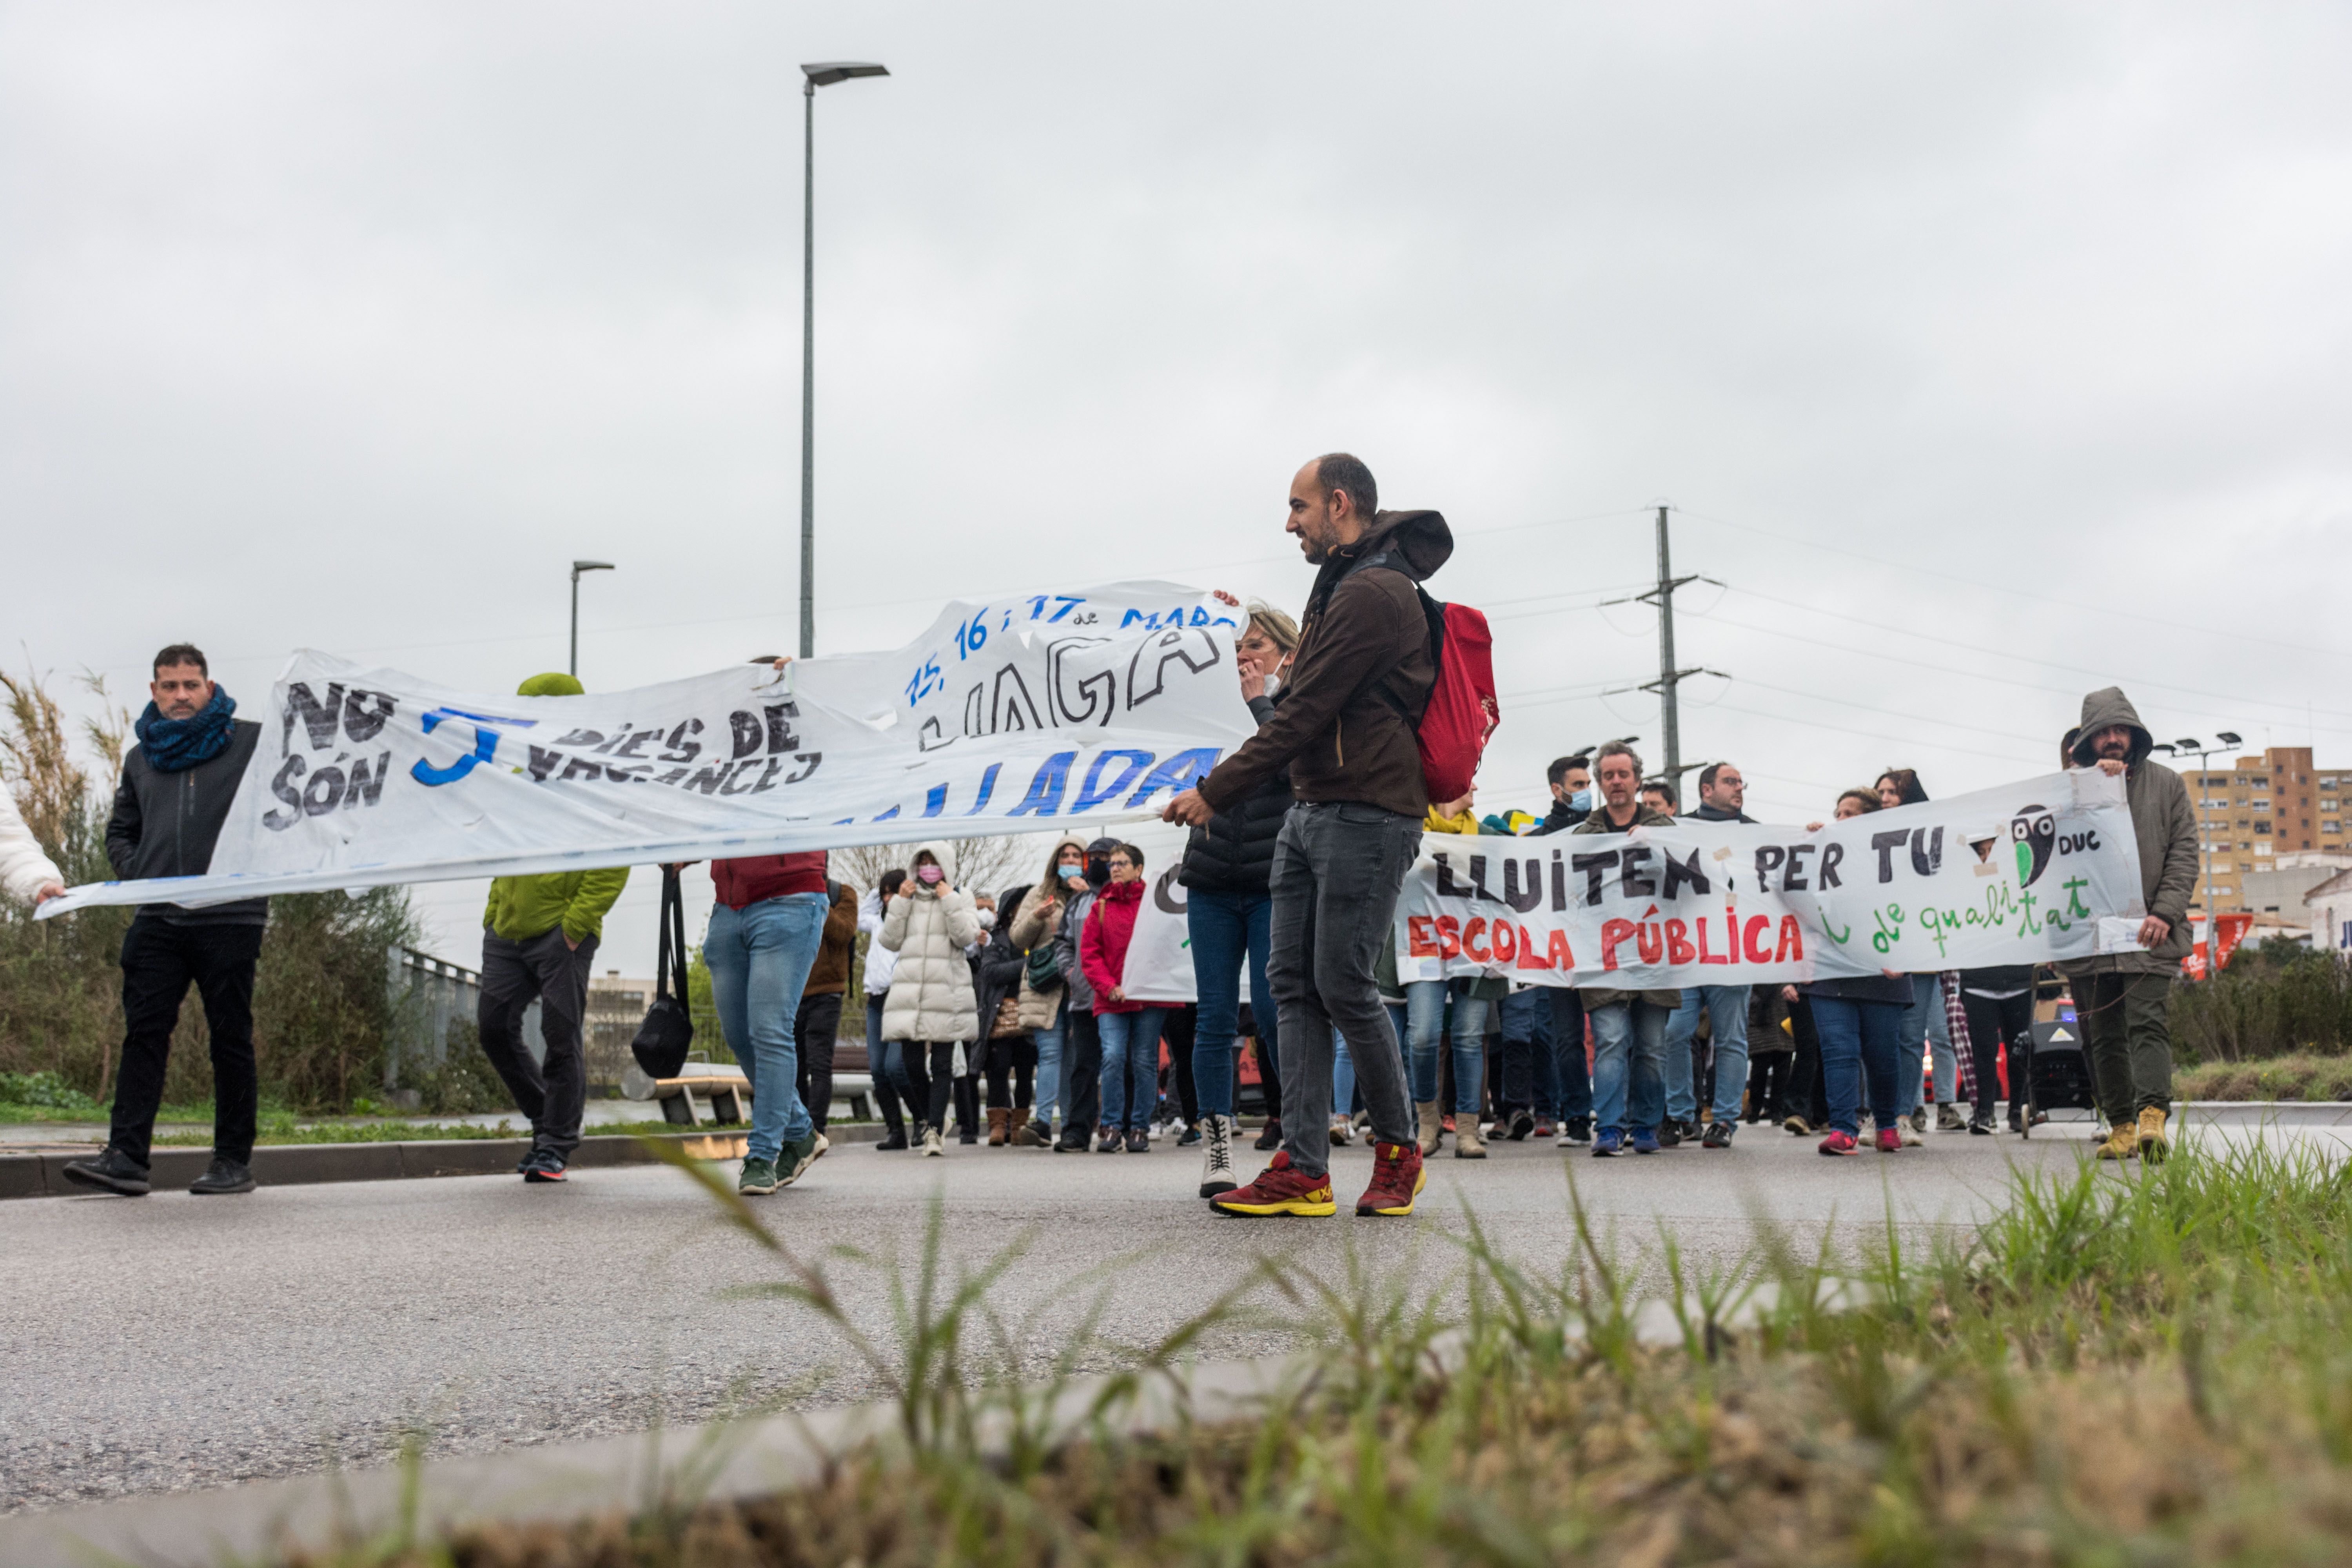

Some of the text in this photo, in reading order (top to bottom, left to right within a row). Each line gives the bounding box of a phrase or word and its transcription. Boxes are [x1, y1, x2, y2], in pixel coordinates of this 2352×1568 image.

[955, 606, 987, 661] 16
[1026, 595, 1087, 623] 17
[1073, 612, 1098, 624] de
[282, 682, 397, 759] NO
[729, 701, 800, 760] DE
[262, 751, 391, 832] SÓN
[1755, 842, 1845, 894] PER
[1871, 826, 1944, 884] TU
[2059, 830, 2101, 855] DUC
[1408, 915, 1575, 971] ESCOLA
[1872, 903, 1905, 953] de
[1919, 875, 2090, 958] qualitat
